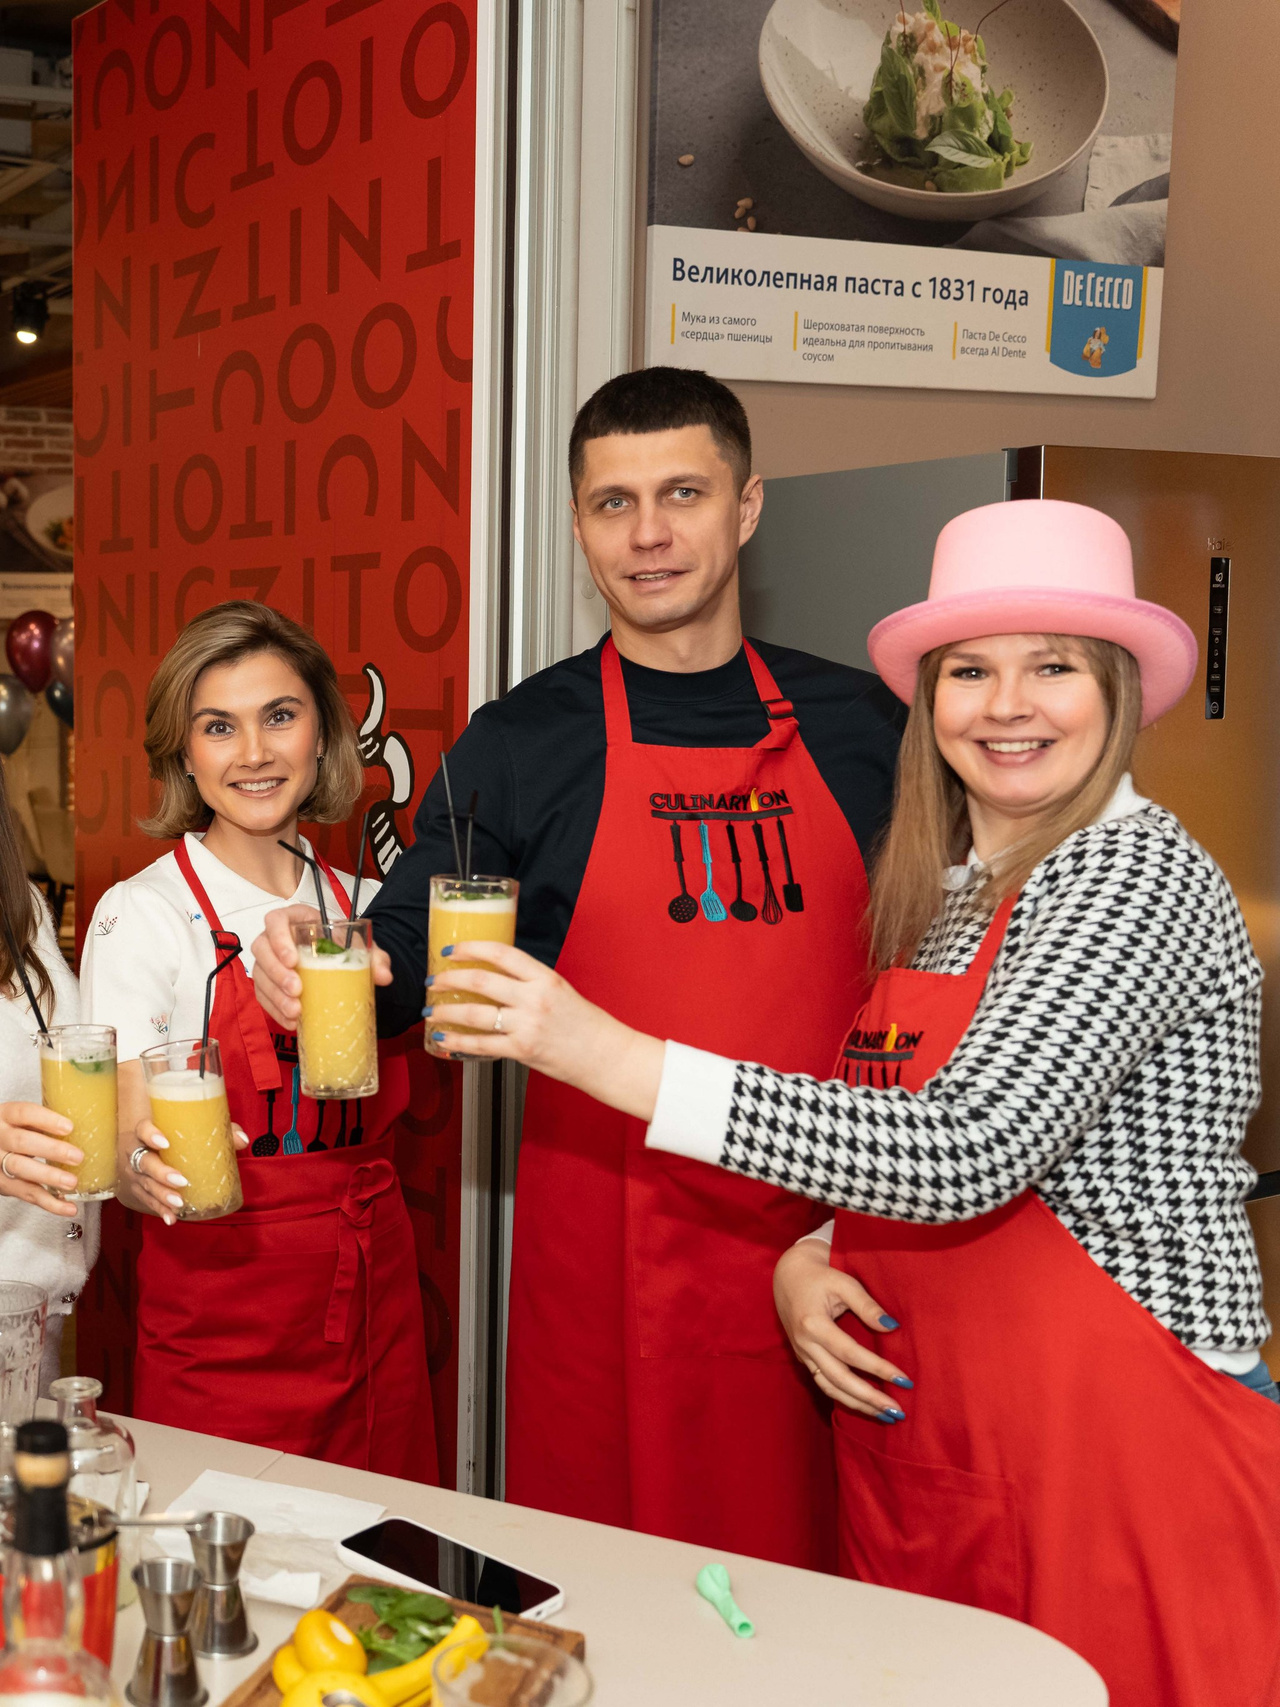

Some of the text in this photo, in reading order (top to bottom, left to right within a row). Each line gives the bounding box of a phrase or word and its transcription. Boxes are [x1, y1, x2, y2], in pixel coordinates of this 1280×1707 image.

[672, 257, 1029, 311] Великолепная паста с 1831 года
[1085, 272, 1134, 310] CECCO
[681, 311, 757, 327] Мука из самого
[803, 319, 926, 337] Шероховатая поверхность
[962, 328, 1027, 344] Паста De Cecco
[680, 330, 773, 345] «сердца» пшеницы
[802, 336, 934, 353] идеальна для пропитывания
[802, 352, 835, 364] соусом
[960, 346, 1027, 359] всегда Al Dente
